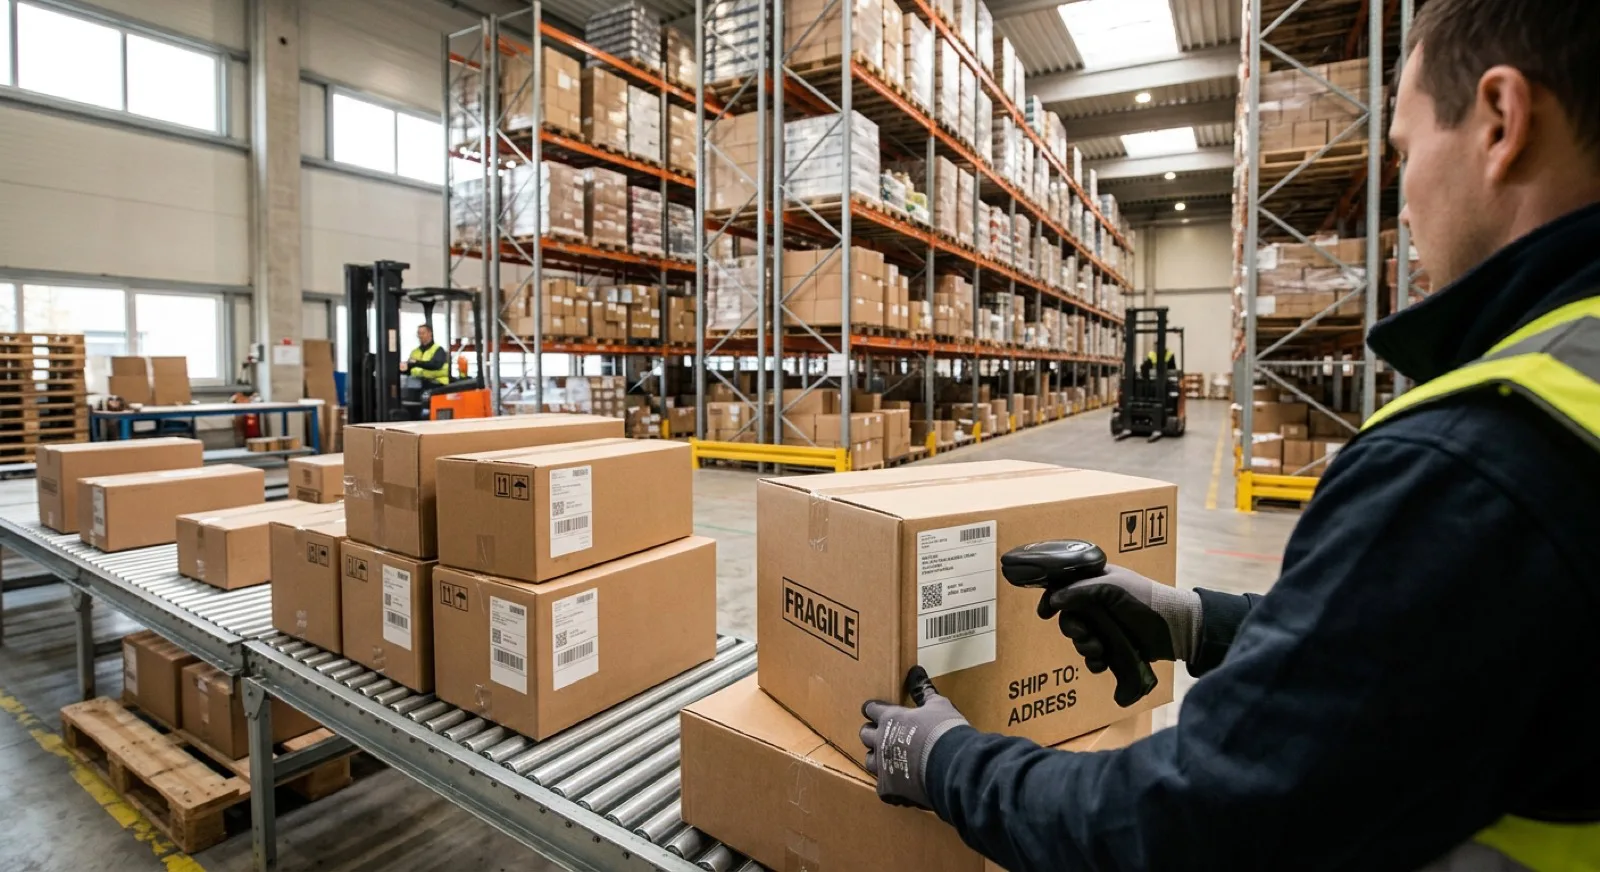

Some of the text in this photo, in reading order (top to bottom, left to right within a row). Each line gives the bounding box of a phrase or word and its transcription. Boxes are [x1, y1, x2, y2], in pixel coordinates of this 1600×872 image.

[785, 587, 855, 649] FRAGILE
[1008, 665, 1079, 700] SHIP TO:
[1008, 689, 1077, 727] ADRESS
